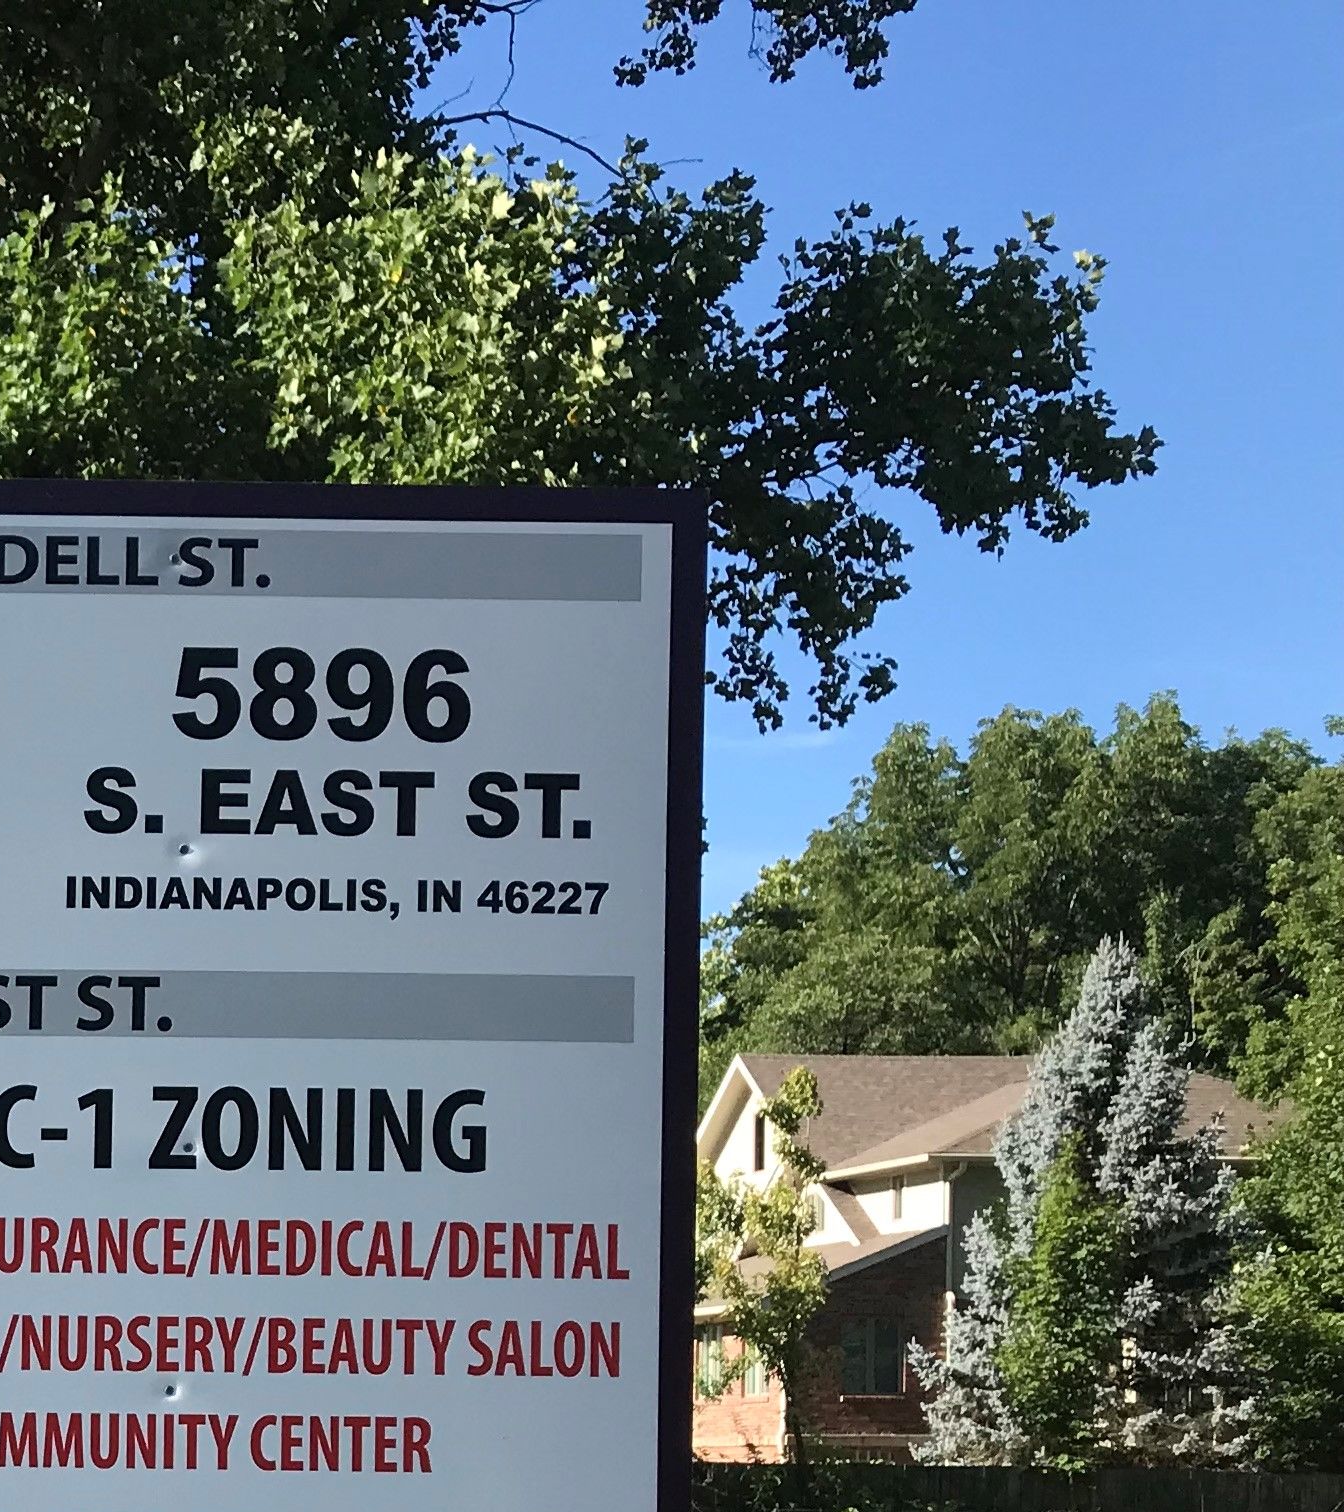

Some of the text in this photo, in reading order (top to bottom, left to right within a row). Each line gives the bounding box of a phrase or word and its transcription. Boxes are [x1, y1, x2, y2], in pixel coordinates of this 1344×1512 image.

[179, 537, 270, 588] ST.
[172, 647, 471, 743] 5896
[84, 767, 591, 839] S. EAST ST.
[66, 876, 609, 917] INDIANAPOLIS, IN 46227
[77, 976, 172, 1031] ST.
[149, 1086, 486, 1173] ZONING
[467, 1320, 620, 1377] SALON
[251, 1415, 432, 1473] CENTER
